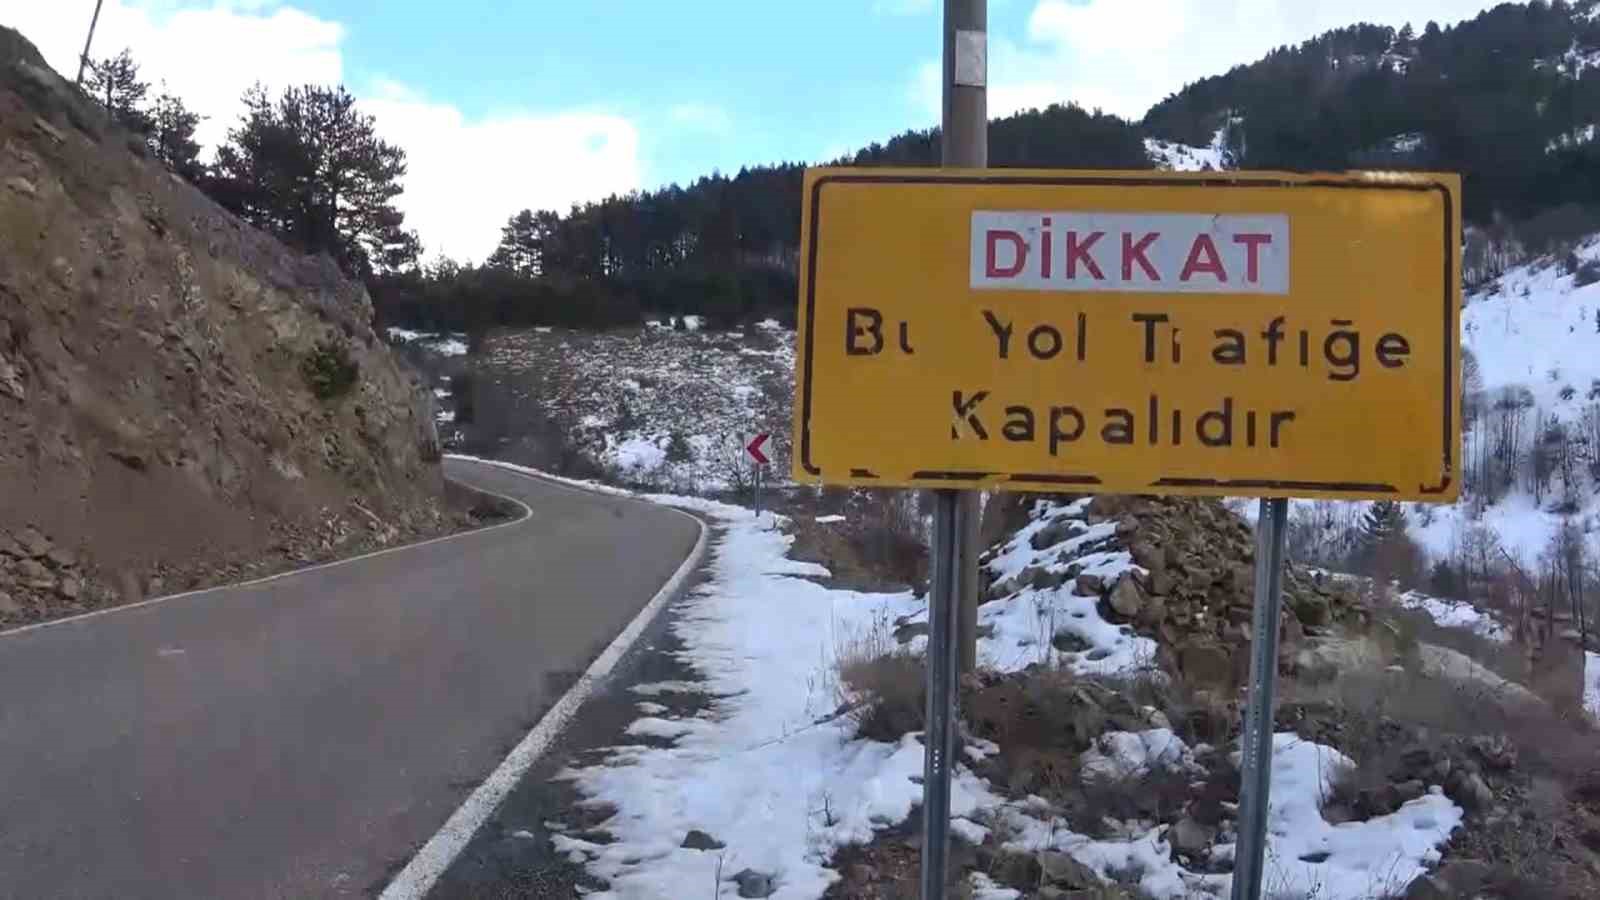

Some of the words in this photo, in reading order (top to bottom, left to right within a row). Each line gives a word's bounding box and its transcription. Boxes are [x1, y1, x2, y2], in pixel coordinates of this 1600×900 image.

[984, 216, 1273, 283] DİKKAT
[981, 309, 1087, 361] Yol
[951, 389, 1297, 456] Kapalıdır
